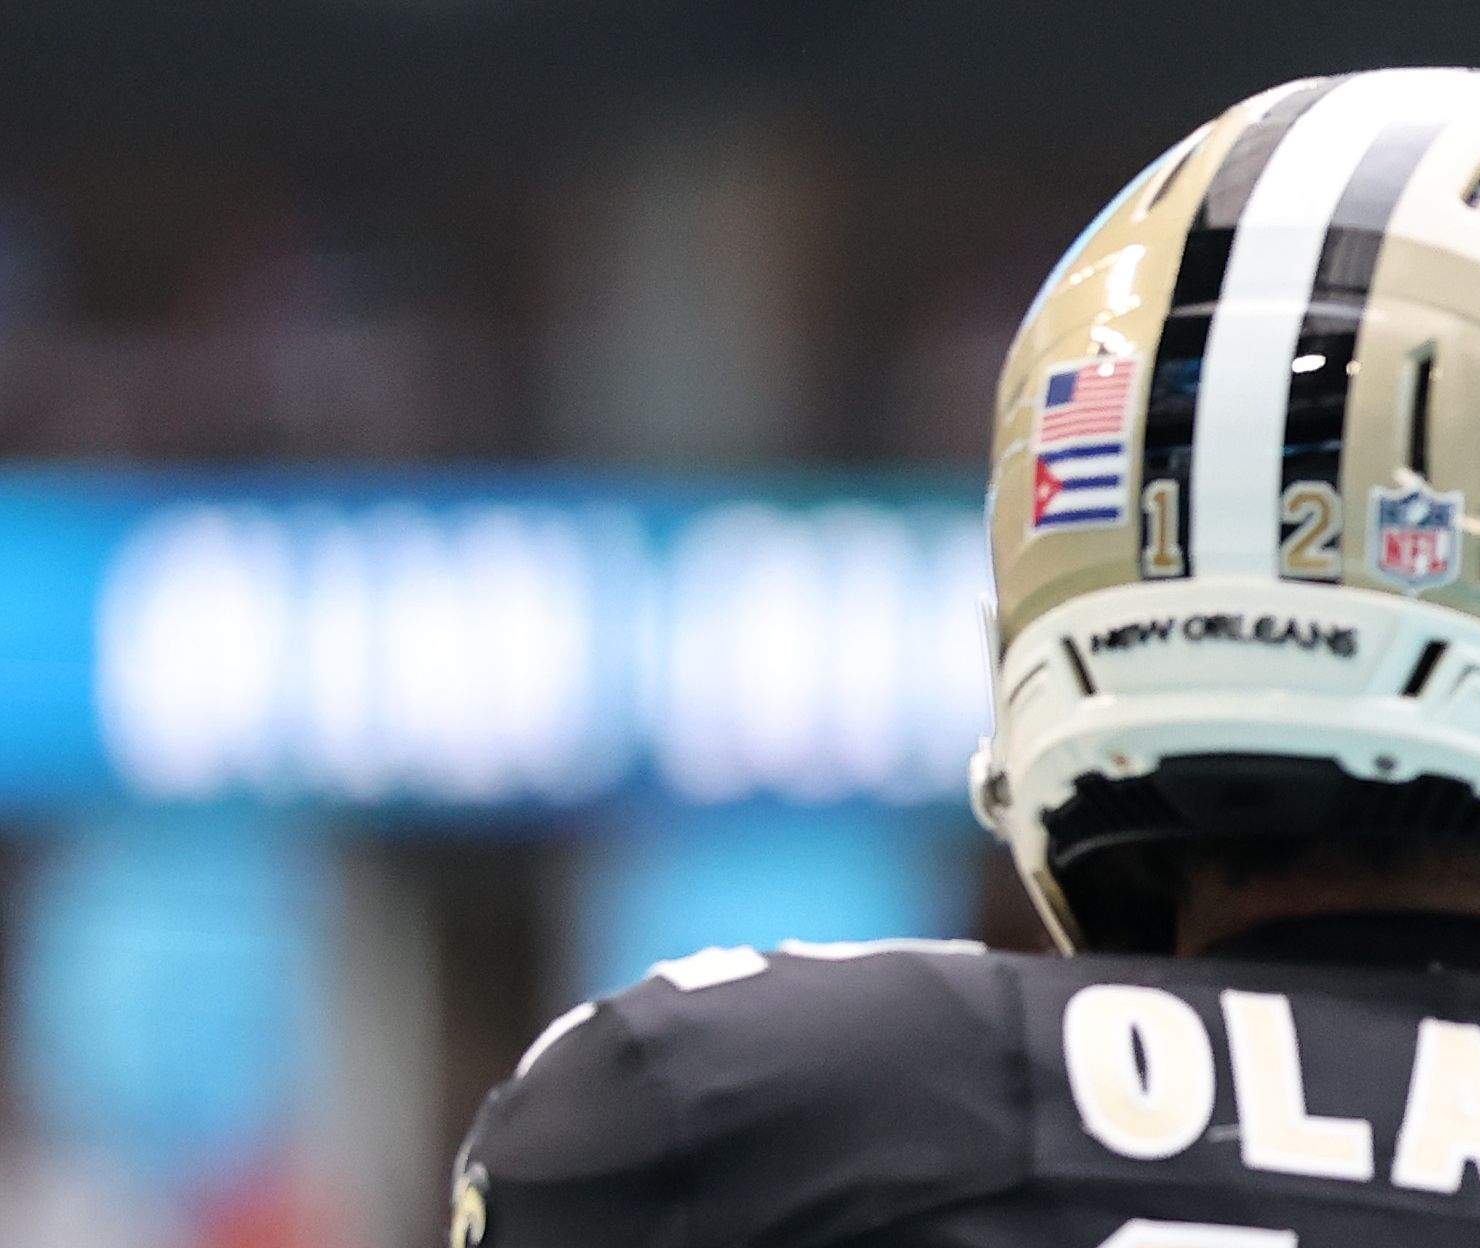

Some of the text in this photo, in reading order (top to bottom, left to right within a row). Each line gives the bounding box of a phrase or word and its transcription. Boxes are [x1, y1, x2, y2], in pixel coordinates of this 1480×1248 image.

[1379, 529, 1449, 577] NFL
[1090, 614, 1358, 658] NEW ORLEANS
